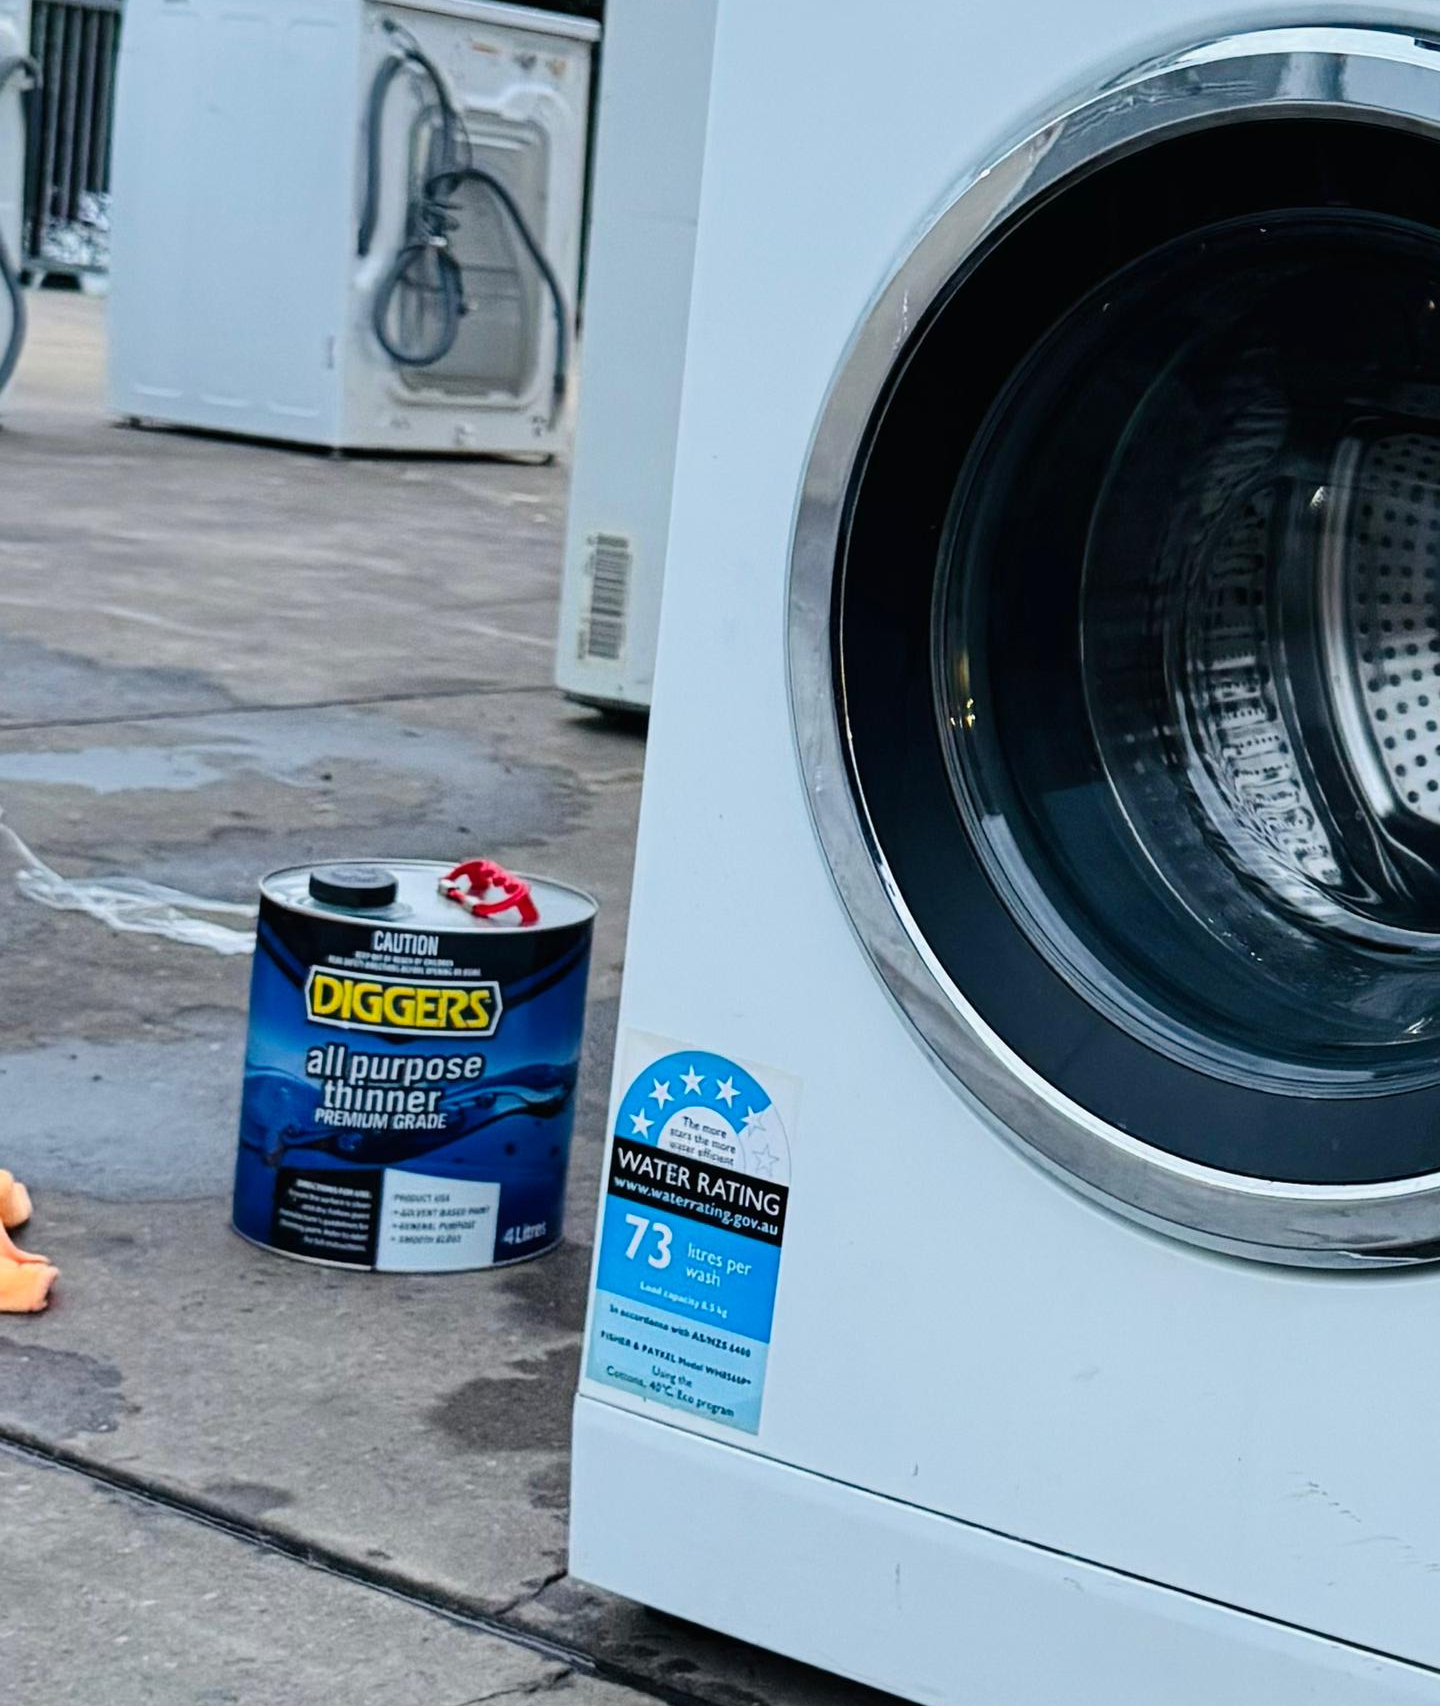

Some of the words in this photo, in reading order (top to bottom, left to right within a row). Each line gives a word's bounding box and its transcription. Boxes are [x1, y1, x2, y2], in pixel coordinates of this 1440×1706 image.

[373, 930, 439, 956] CAUTION
[313, 974, 490, 1029] DIGGERS
[307, 1044, 345, 1077] all
[350, 1054, 483, 1087] purpose
[324, 1079, 442, 1113] thinner
[315, 1108, 389, 1129] PREMIUM
[393, 1113, 448, 1130] GRADE
[683, 1116, 700, 1131] The
[617, 1146, 691, 1190] WATER
[697, 1172, 781, 1217] RATING
[613, 1174, 779, 1236] www.waterrating.gov.au
[625, 1213, 672, 1269] 73
[688, 1242, 723, 1267] litres
[726, 1259, 752, 1276] per
[686, 1267, 721, 1287] wash
